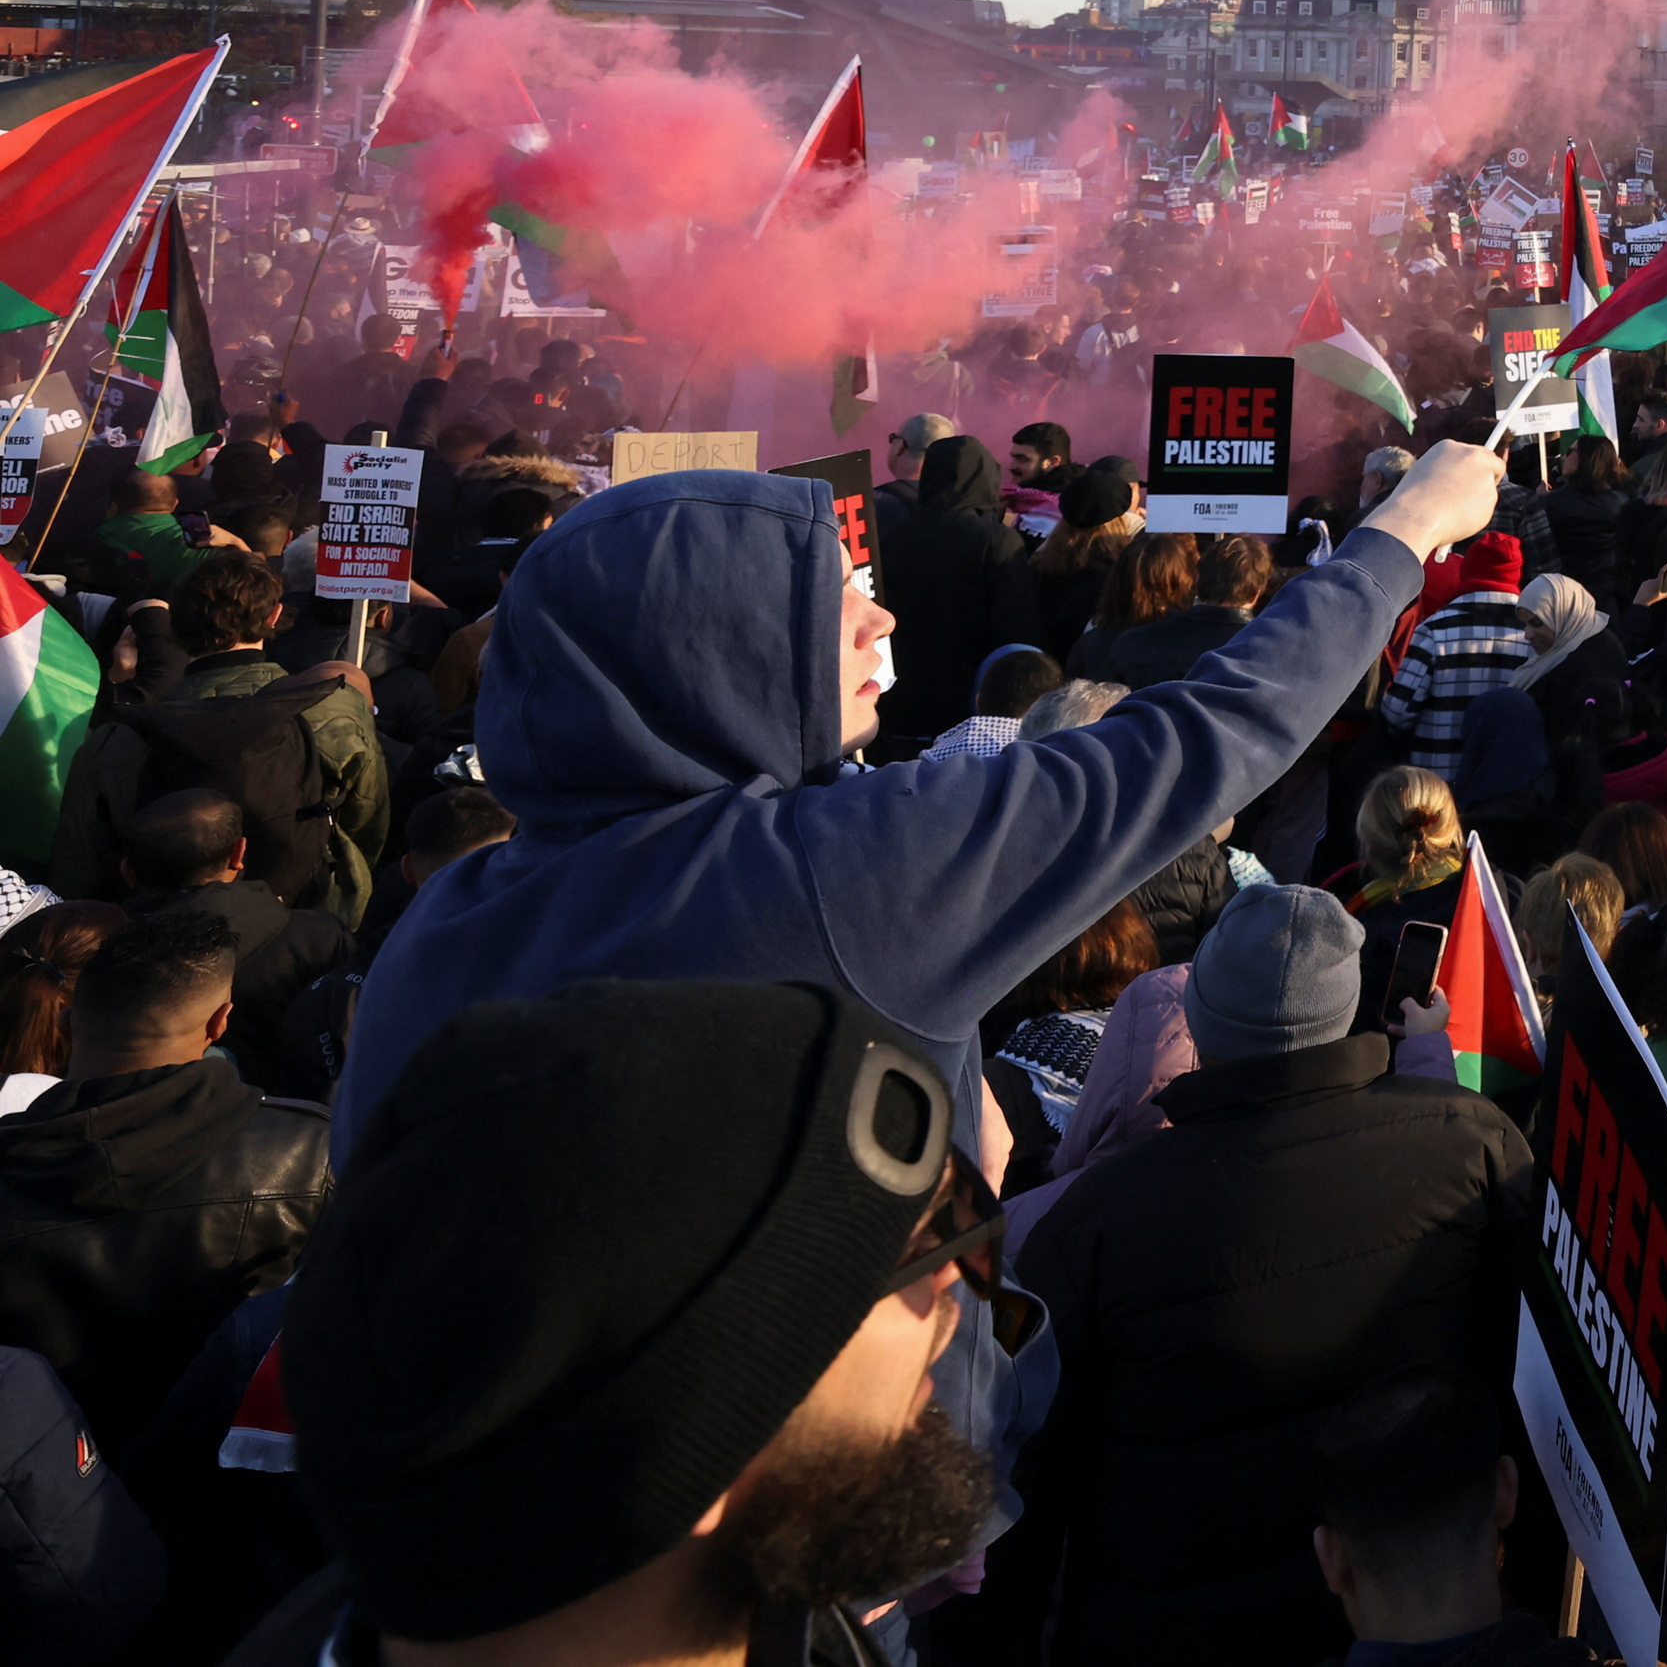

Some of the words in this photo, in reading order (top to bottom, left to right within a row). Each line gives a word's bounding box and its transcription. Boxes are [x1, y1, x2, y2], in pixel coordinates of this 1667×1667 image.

[1508, 152, 1527, 163] 30
[1314, 208, 1340, 218] Free
[1299, 219, 1353, 230] Palestine
[1482, 227, 1512, 238] FREEDOM
[1478, 238, 1511, 250] PALESTINE
[1517, 239, 1549, 250] FREEOM
[1516, 252, 1551, 264] PALESNE
[1629, 256, 1653, 267] PALES
[508, 297, 530, 306] Stop
[1504, 330, 1535, 352] END
[1533, 328, 1560, 350] THE
[1505, 350, 1558, 382] SIE
[1167, 386, 1277, 438] FREE
[358, 453, 407, 464] Socialist
[627, 442, 744, 474] DEPORT
[1164, 440, 1275, 465] PALESTINE
[327, 477, 347, 488] MASS
[349, 478, 378, 489] UNITED
[381, 479, 414, 491] WORKERS'
[344, 489, 387, 501] STRUGGLE
[389, 492, 398, 501] TO
[328, 504, 355, 524] END
[358, 505, 407, 526] ISRAELI
[1194, 503, 1211, 515] FOA
[321, 523, 360, 542] STATE
[363, 525, 410, 546] TERROR
[325, 545, 341, 560] FOR
[343, 546, 353, 560] A
[355, 547, 402, 563] SOCIALIST
[339, 562, 389, 576] INTIFADA
[1542, 1176, 1657, 1482] PALESTINE
[1556, 1416, 1573, 1481] FOA
[1577, 1465, 1604, 1528] FRIENDS
